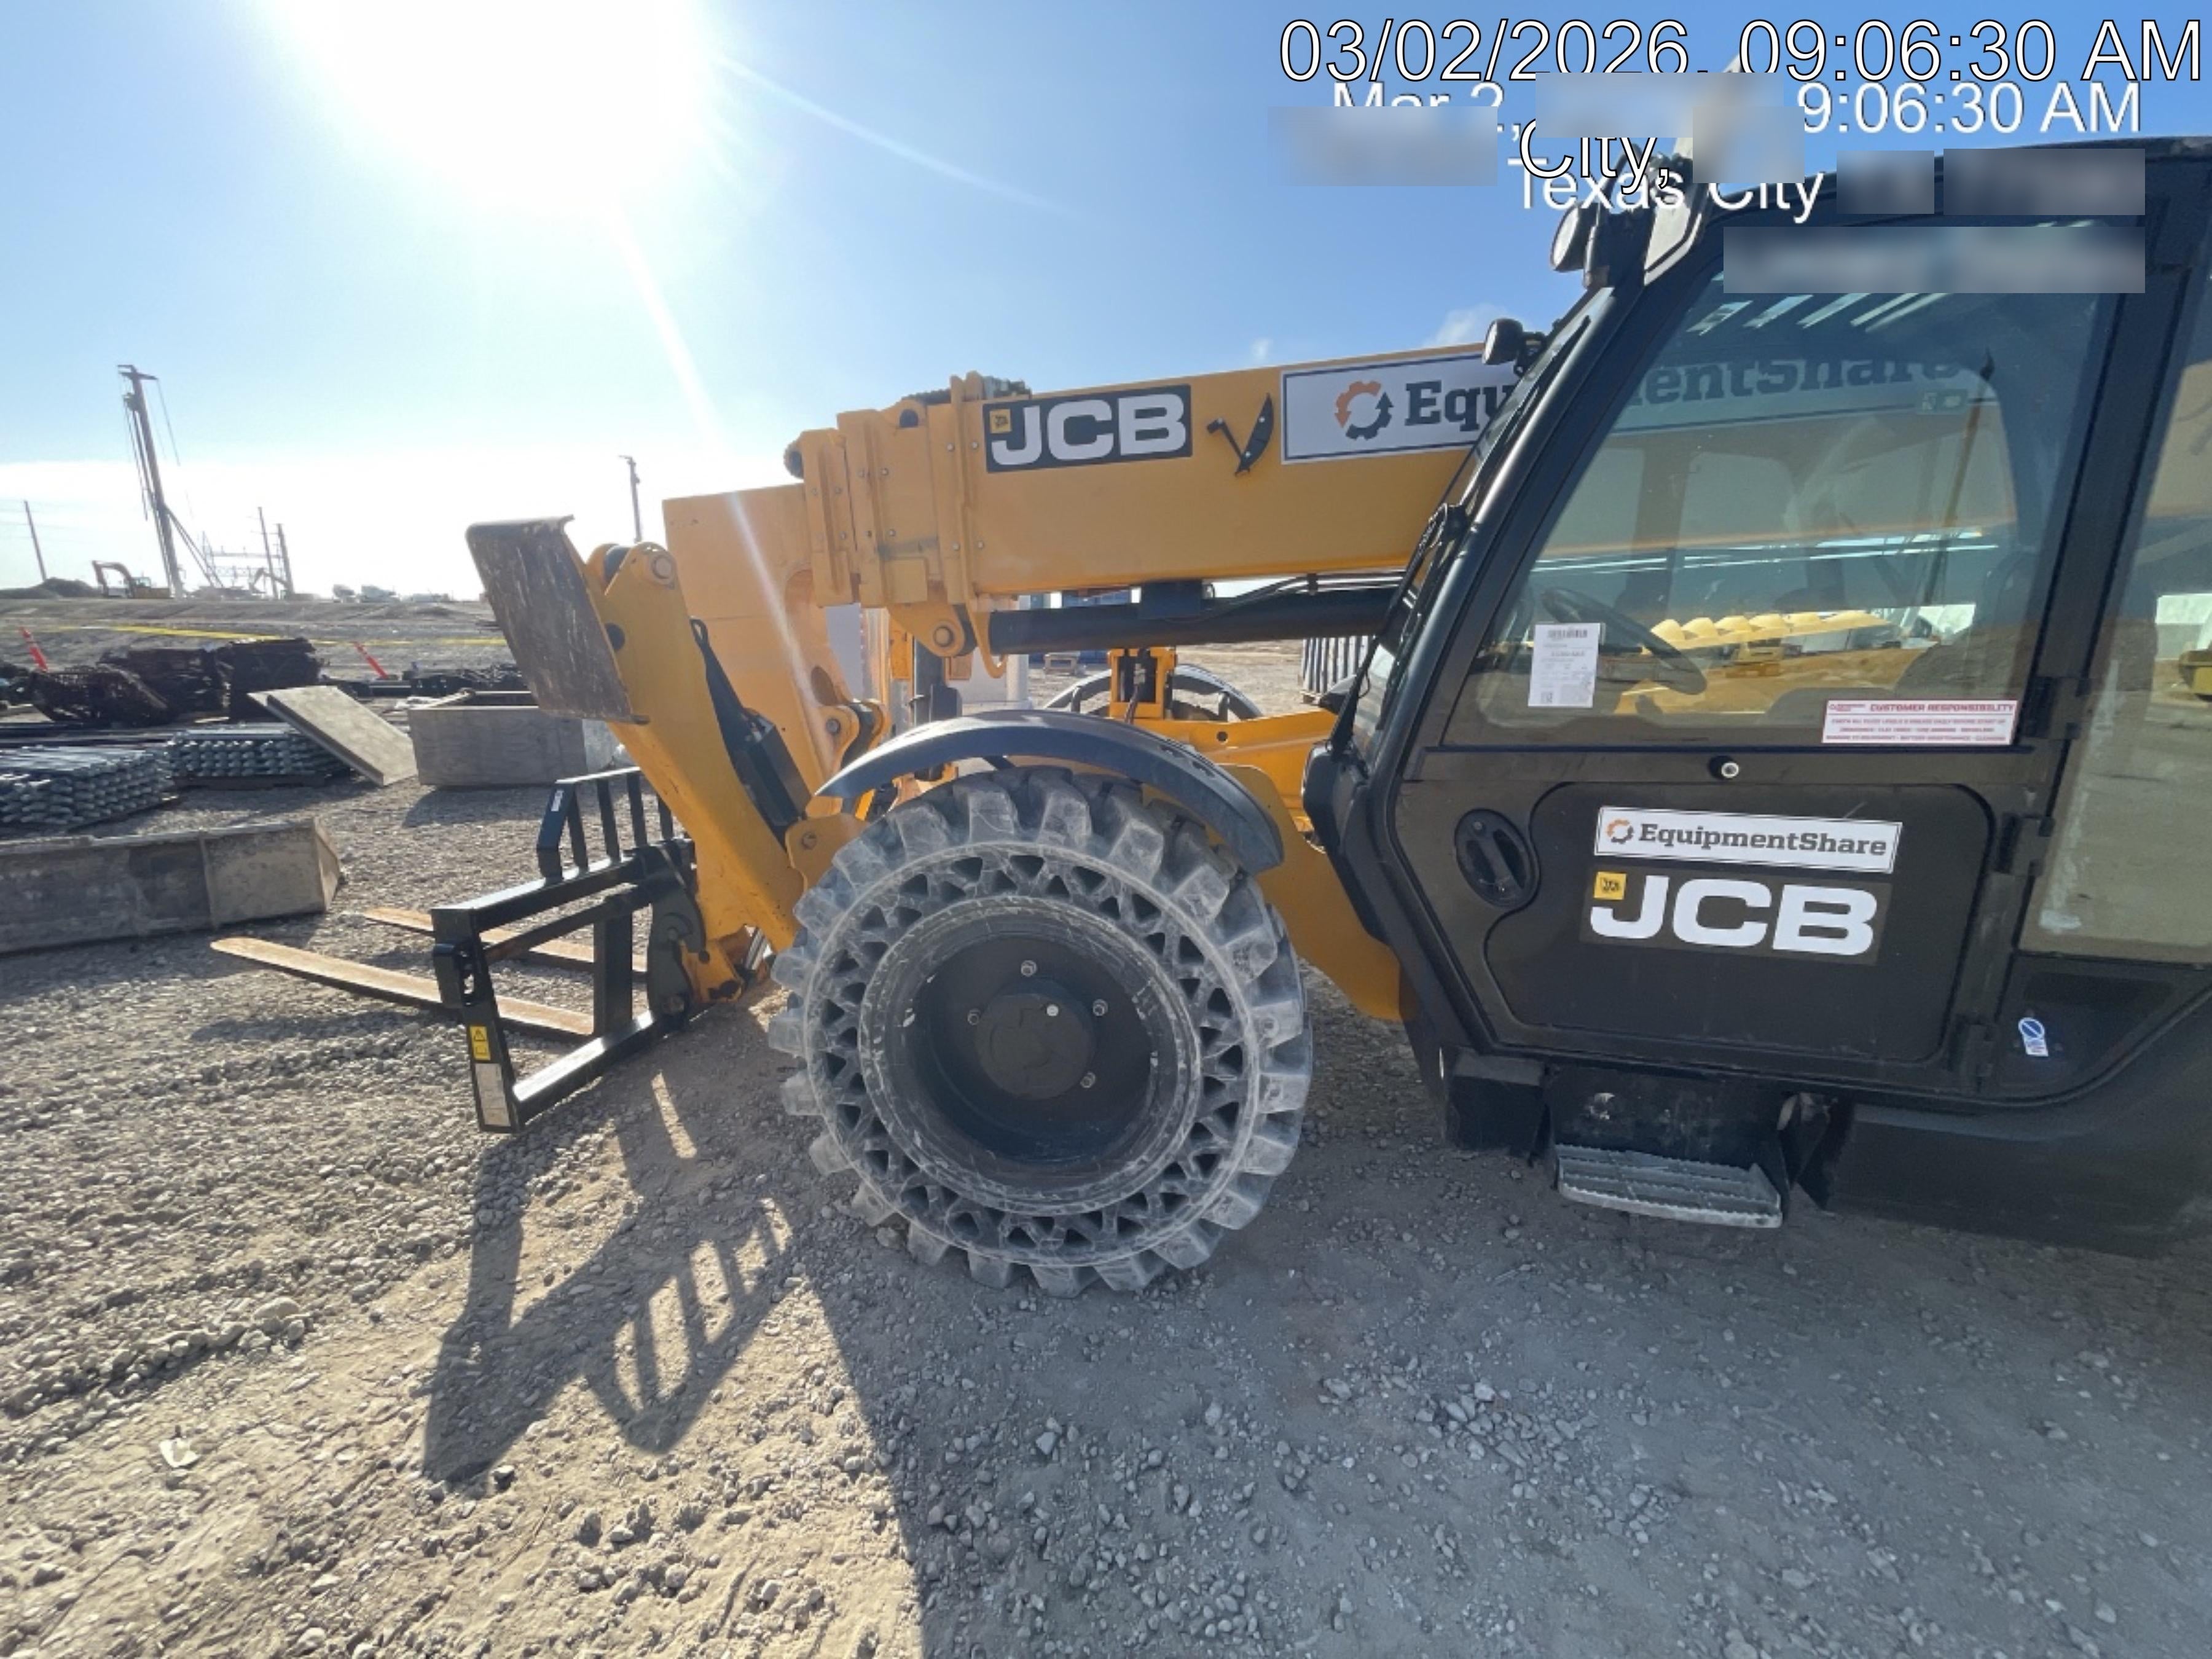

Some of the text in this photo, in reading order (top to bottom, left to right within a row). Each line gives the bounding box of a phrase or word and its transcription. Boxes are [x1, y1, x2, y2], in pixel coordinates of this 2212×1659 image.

[990, 393, 1186, 465] JCB
[1870, 703, 1925, 712] CUSTOMER
[1928, 703, 2014, 712] RESPONSIBILITY
[1639, 823, 1887, 856] EquipmentShare
[1590, 875, 1878, 956] JCB
